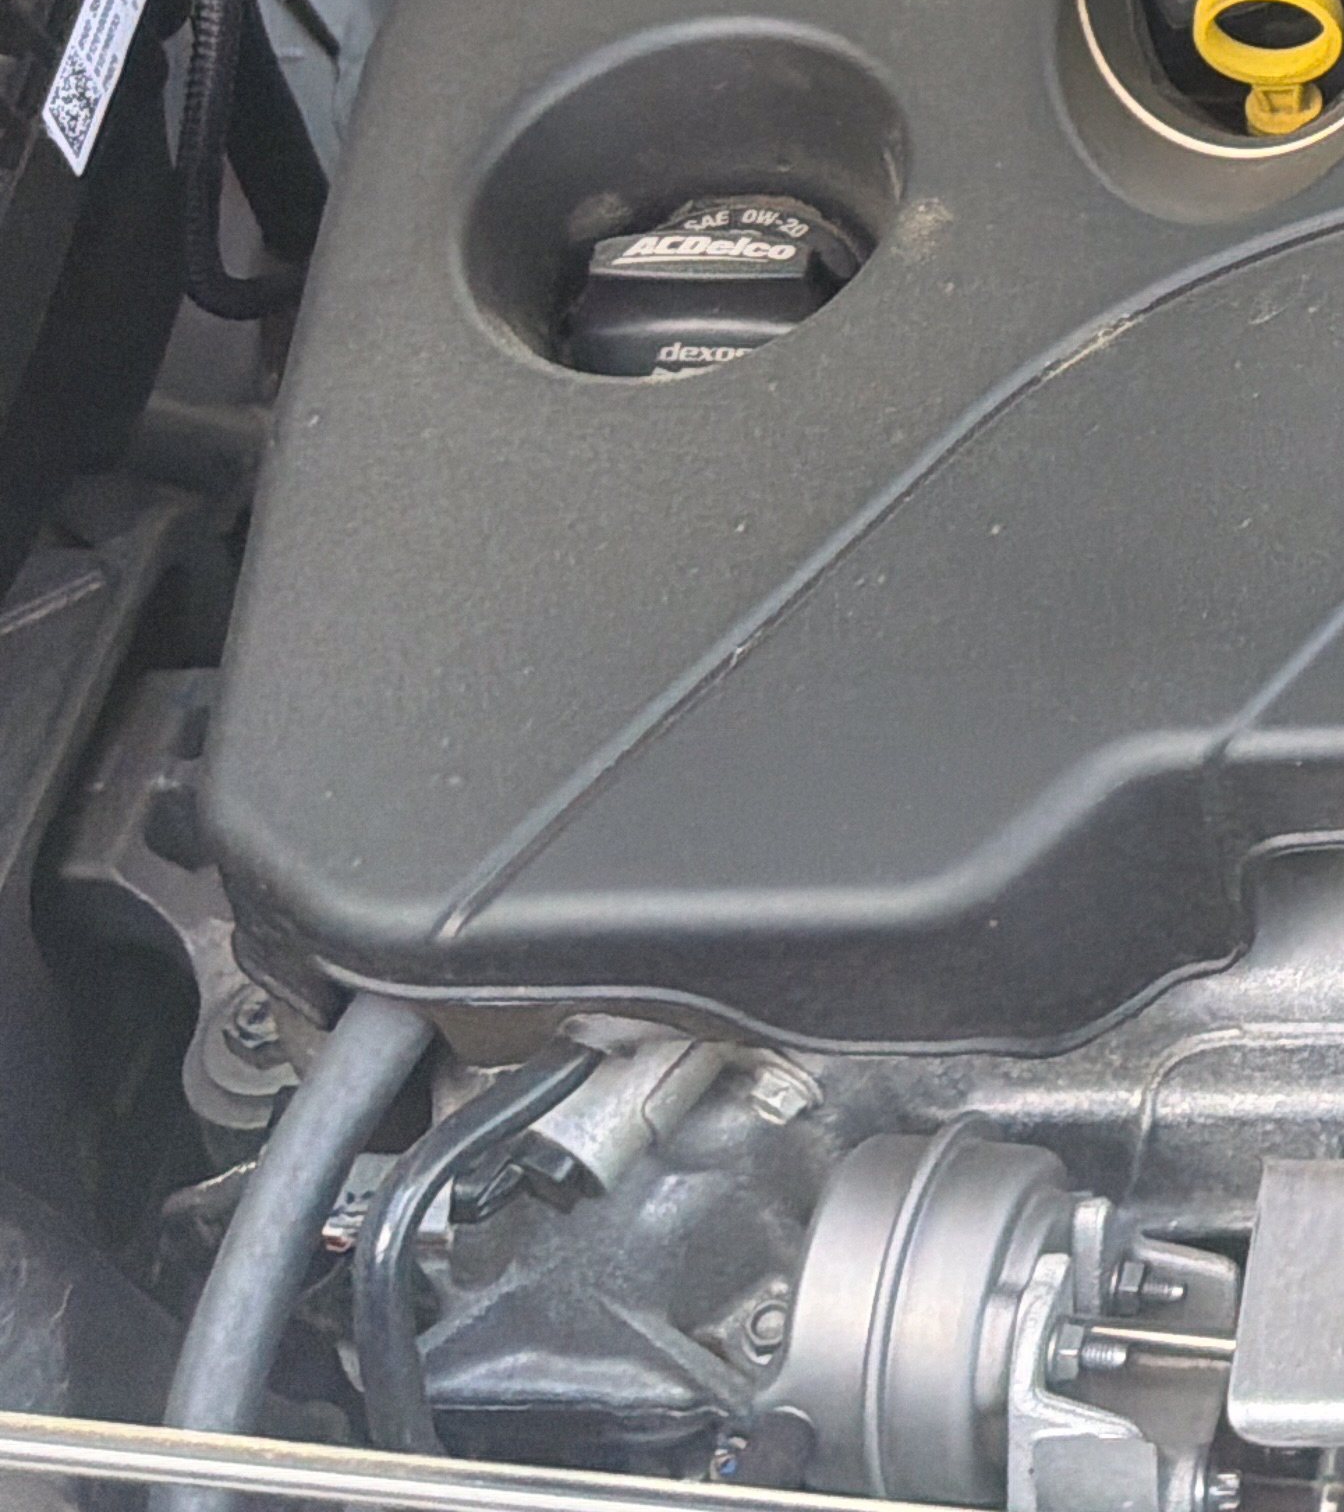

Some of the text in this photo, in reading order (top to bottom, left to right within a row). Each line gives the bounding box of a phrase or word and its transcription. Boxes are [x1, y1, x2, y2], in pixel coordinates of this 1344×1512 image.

[684, 209, 810, 238] SAE 0W-20
[622, 236, 796, 261] ACDelco
